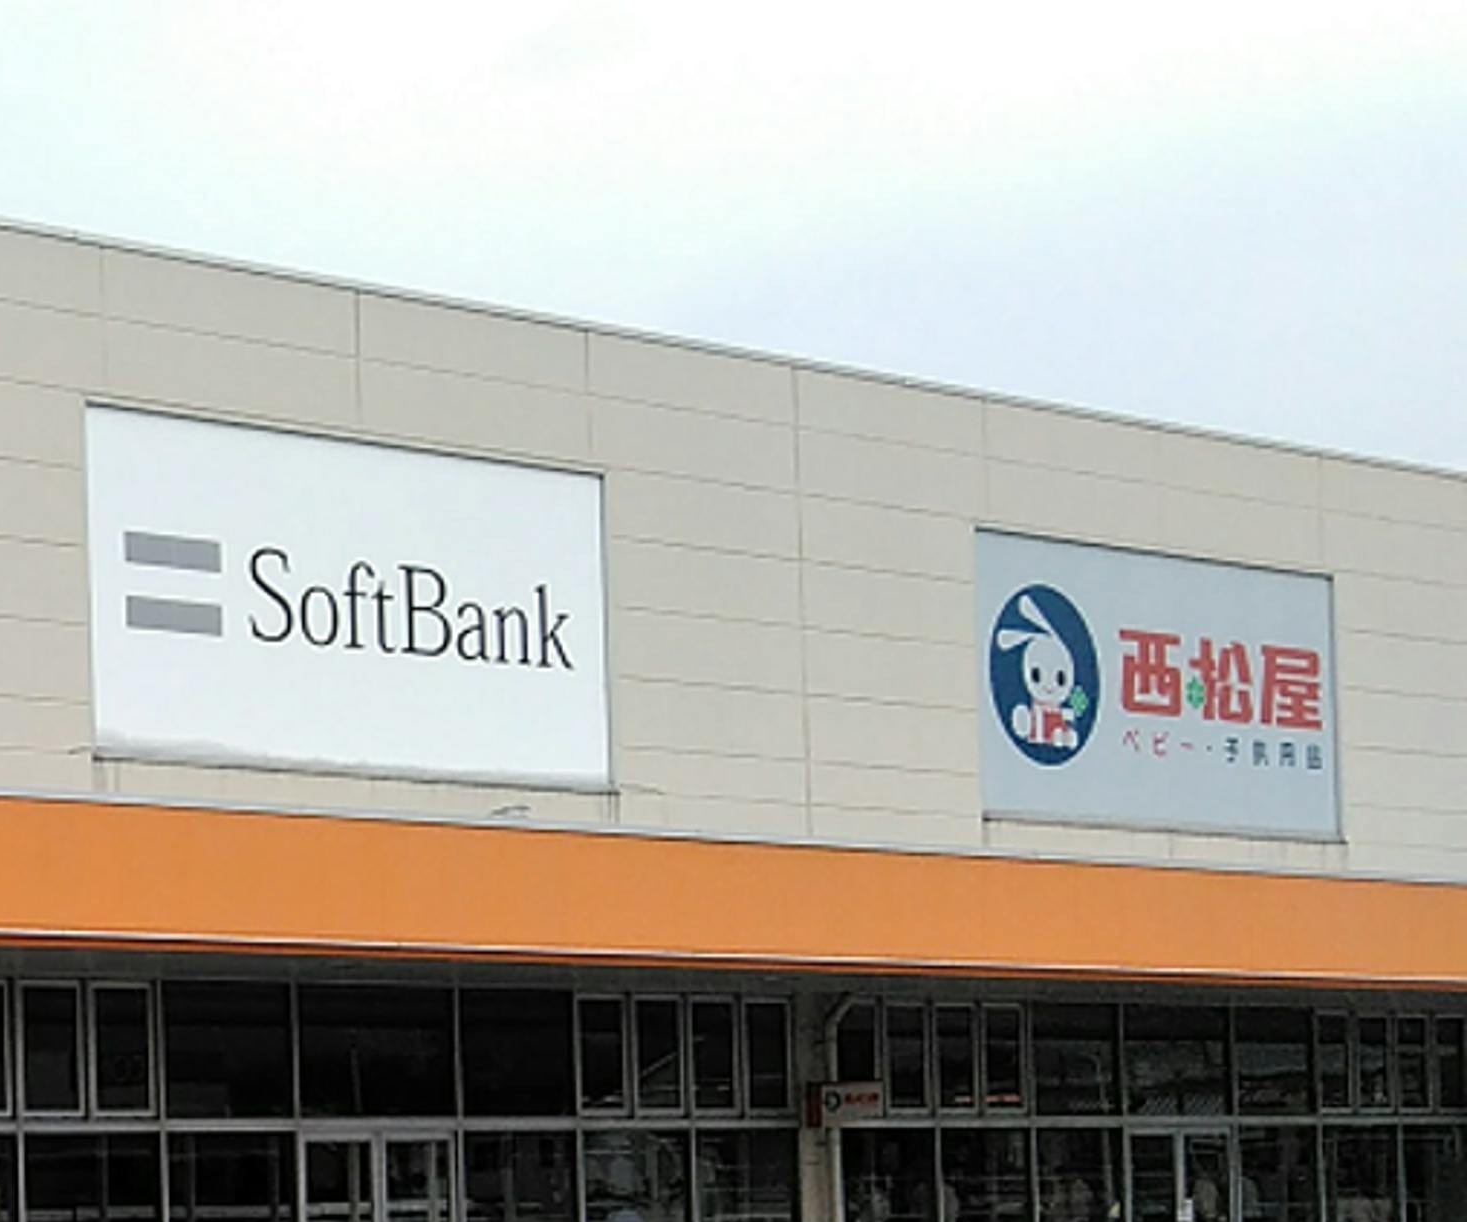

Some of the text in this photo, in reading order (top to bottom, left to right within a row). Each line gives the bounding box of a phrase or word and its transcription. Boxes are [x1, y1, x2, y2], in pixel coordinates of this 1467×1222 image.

[248, 546, 575, 671] SoftBank
[1119, 628, 1323, 730] 西松屋
